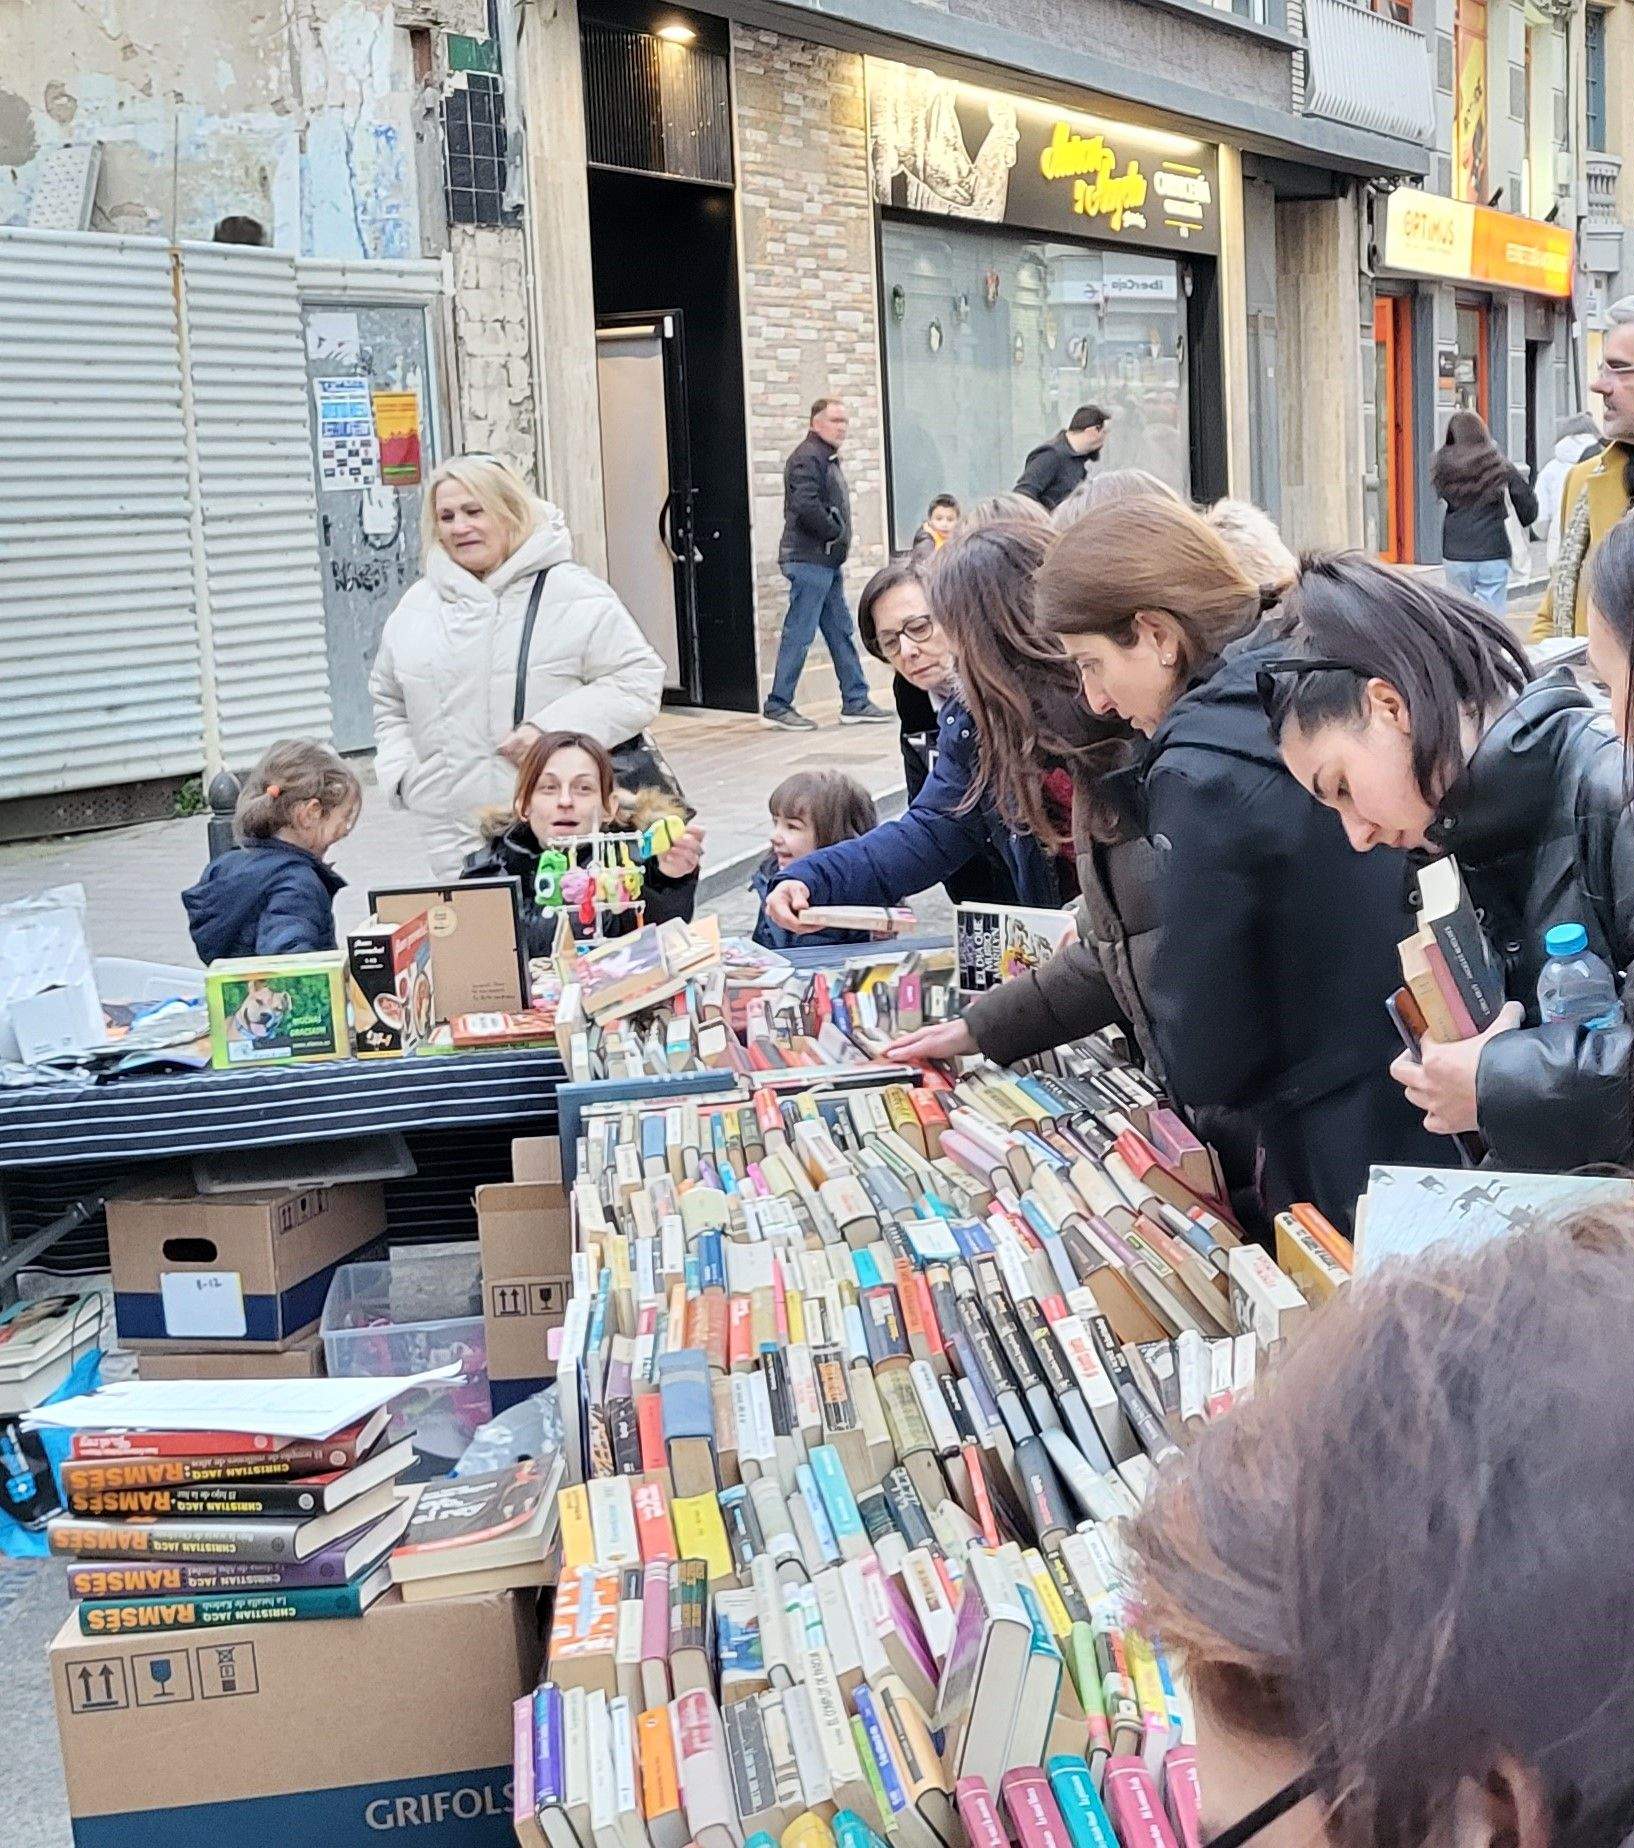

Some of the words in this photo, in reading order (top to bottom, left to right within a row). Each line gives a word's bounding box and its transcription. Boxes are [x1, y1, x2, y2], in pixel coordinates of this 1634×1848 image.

[1404, 210, 1455, 246] OPTIMUS
[70, 1462, 185, 1490] RAMSÉS
[191, 1469, 222, 1480] JACQ
[226, 1463, 290, 1477] CHRISTIAN
[71, 1490, 171, 1515] RAMSÉS
[177, 1502, 204, 1511] JACQ
[206, 1501, 263, 1511] CHRISTIAN
[51, 1530, 148, 1554] RAMSÉS
[152, 1541, 180, 1551] JACQ
[181, 1542, 237, 1553] CHRISTIAN
[74, 1569, 181, 1597] RAMSÉS
[188, 1577, 217, 1587] JACQ
[221, 1574, 281, 1586] CHRISTIAN
[87, 1603, 196, 1633] RAMSÉS
[203, 1611, 232, 1622] JACQ
[235, 1607, 297, 1620] CHRISTIAN
